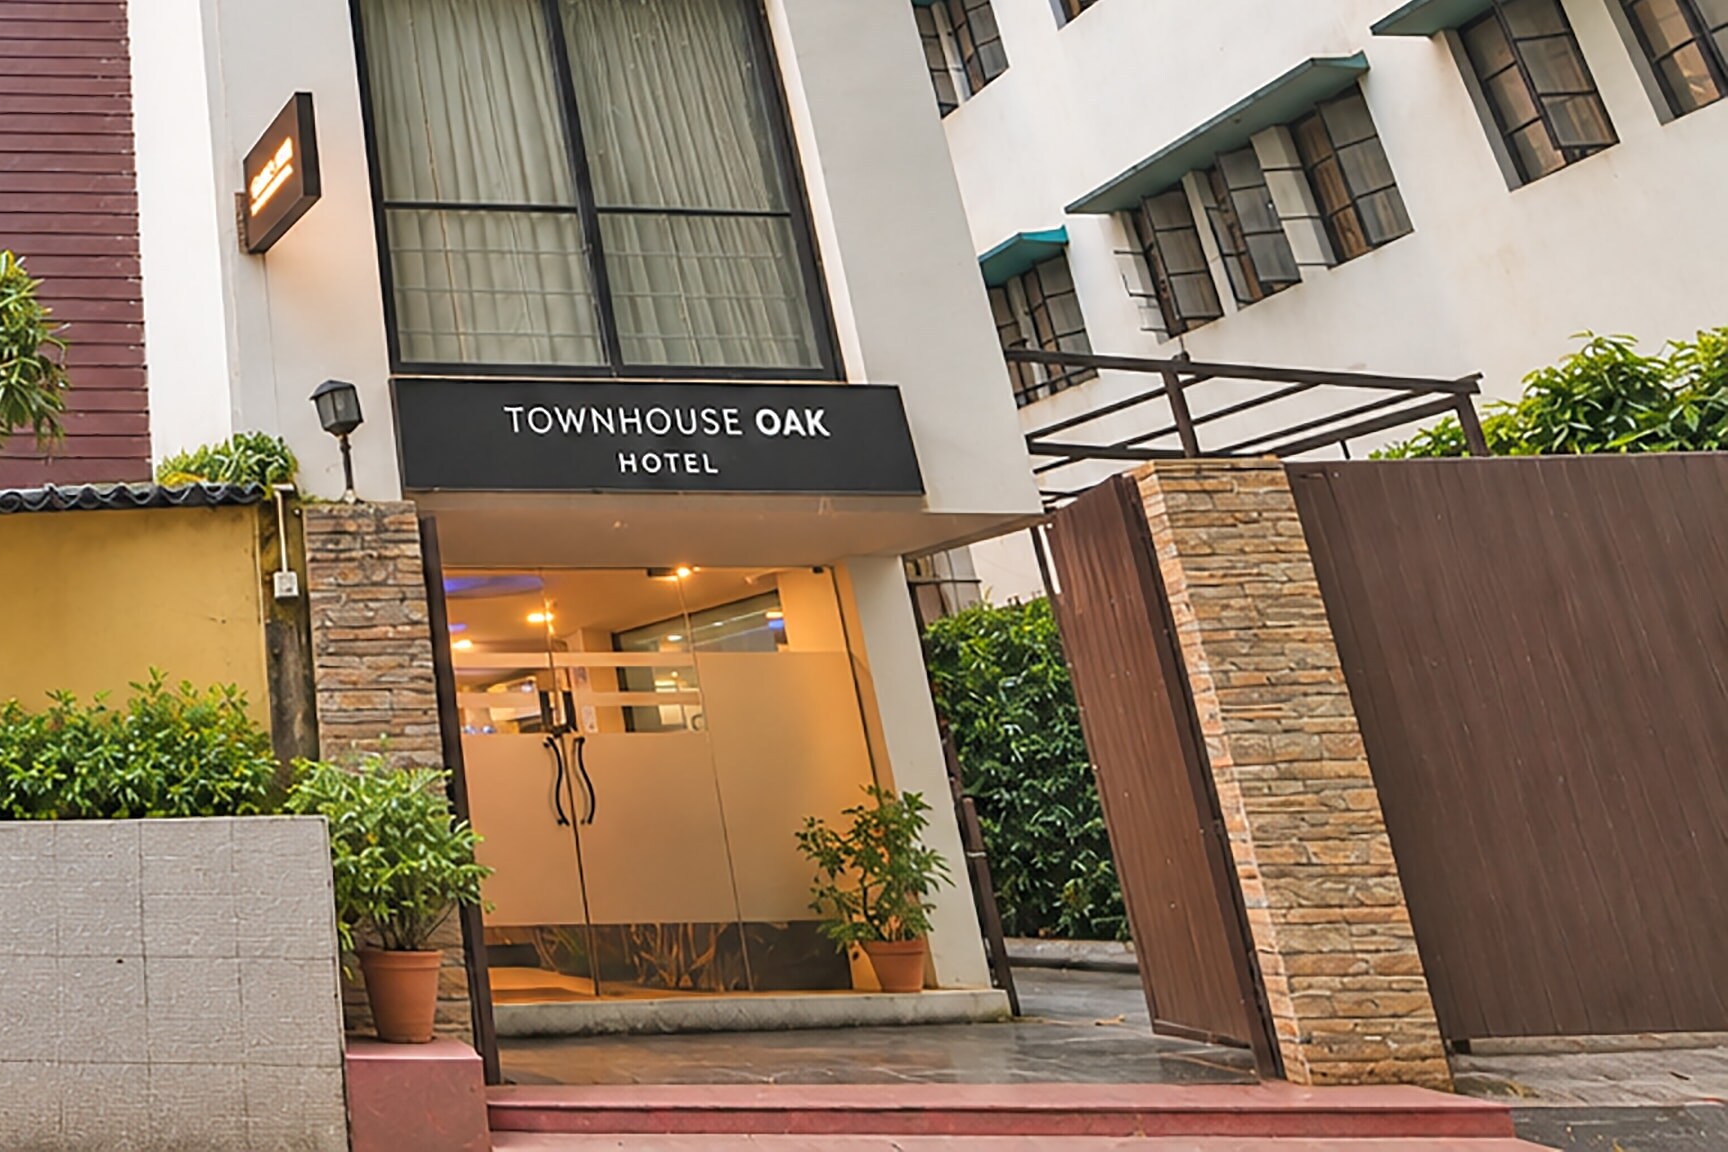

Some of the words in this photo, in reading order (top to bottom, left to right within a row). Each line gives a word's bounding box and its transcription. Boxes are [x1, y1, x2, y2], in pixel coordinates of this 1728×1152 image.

[502, 405, 744, 436] TOWNHOUSE
[754, 407, 832, 438] OAK
[617, 451, 720, 475] HOTEL
